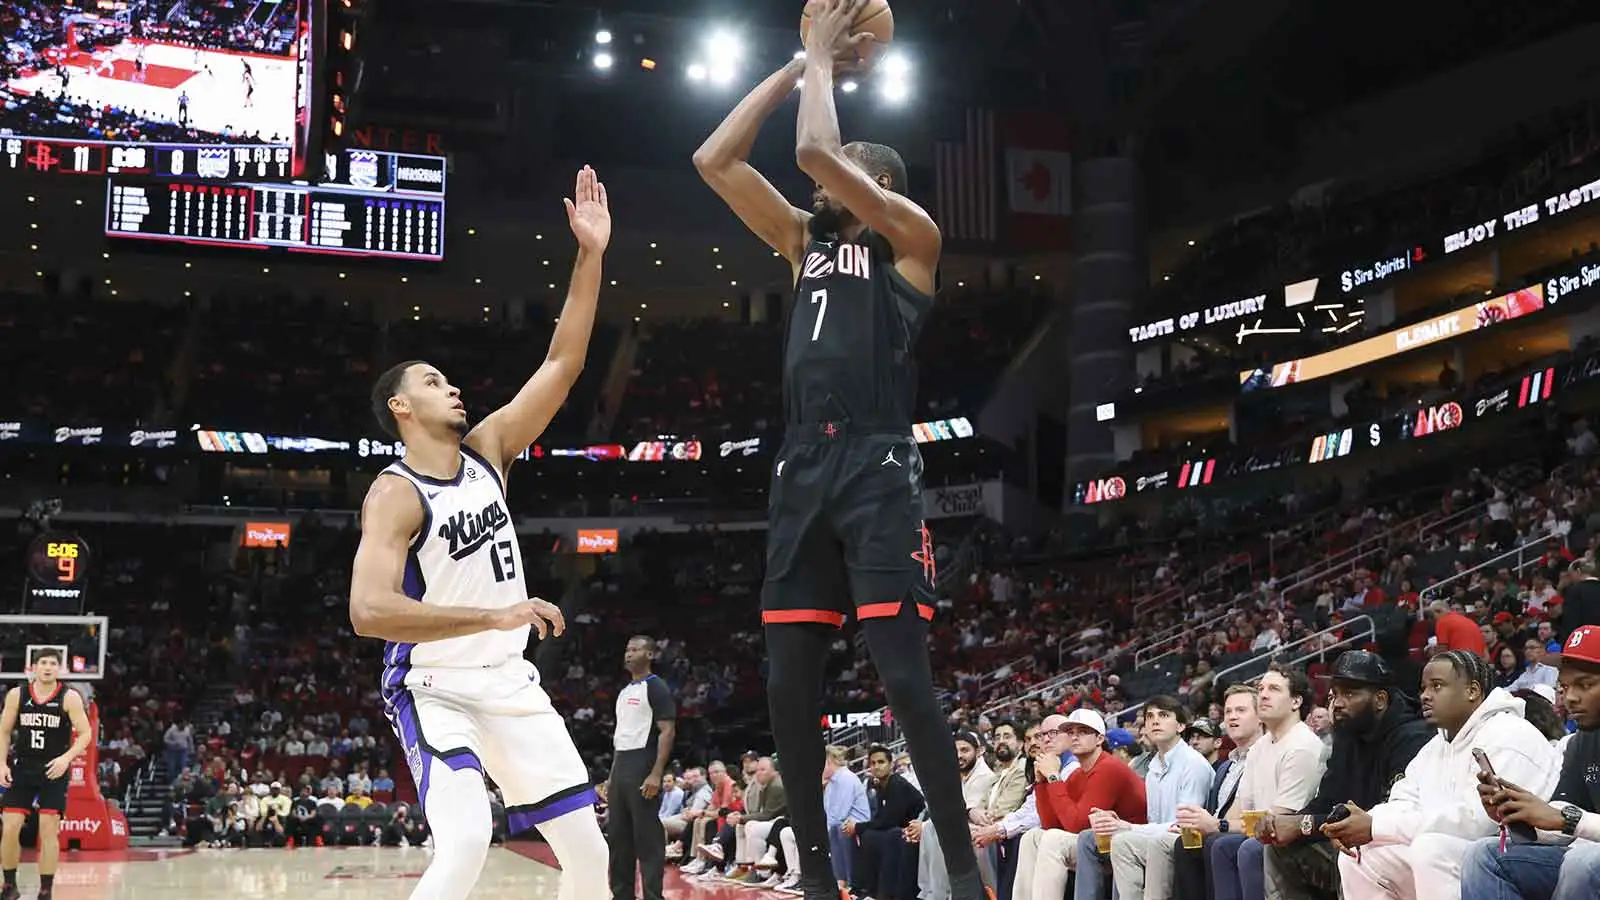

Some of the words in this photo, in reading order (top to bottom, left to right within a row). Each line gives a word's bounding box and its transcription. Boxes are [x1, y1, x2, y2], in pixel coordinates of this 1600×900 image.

[355, 124, 443, 153] NTER
[74, 146, 89, 171] 11
[1444, 219, 1497, 253] ENJOY
[1504, 204, 1539, 231] THE
[810, 288, 828, 341] 7
[1179, 311, 1199, 330] OF
[1204, 295, 1266, 324] LUXURY
[438, 500, 509, 561] Kings
[57, 558, 75, 582] 9
[490, 540, 516, 583] 13
[20, 713, 60, 728] HOUSTON
[30, 730, 45, 749] 15
